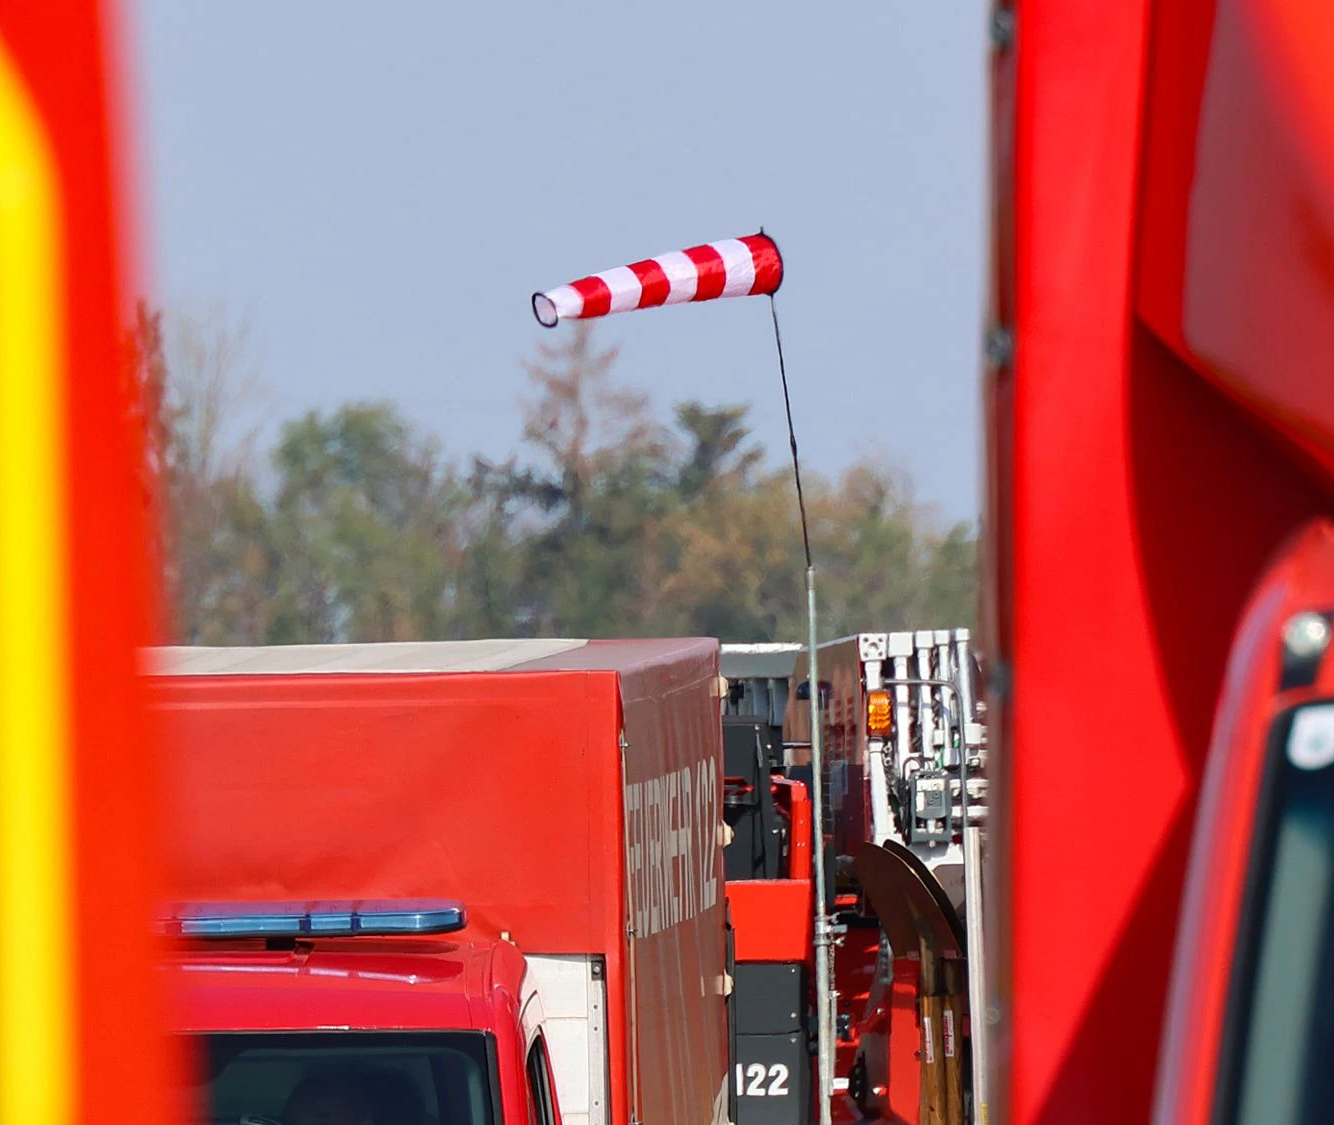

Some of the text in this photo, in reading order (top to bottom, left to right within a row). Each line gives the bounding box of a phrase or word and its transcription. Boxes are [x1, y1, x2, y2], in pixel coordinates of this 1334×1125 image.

[626, 755, 717, 939] FEUERWEHR 122
[736, 1063, 789, 1097] 122
